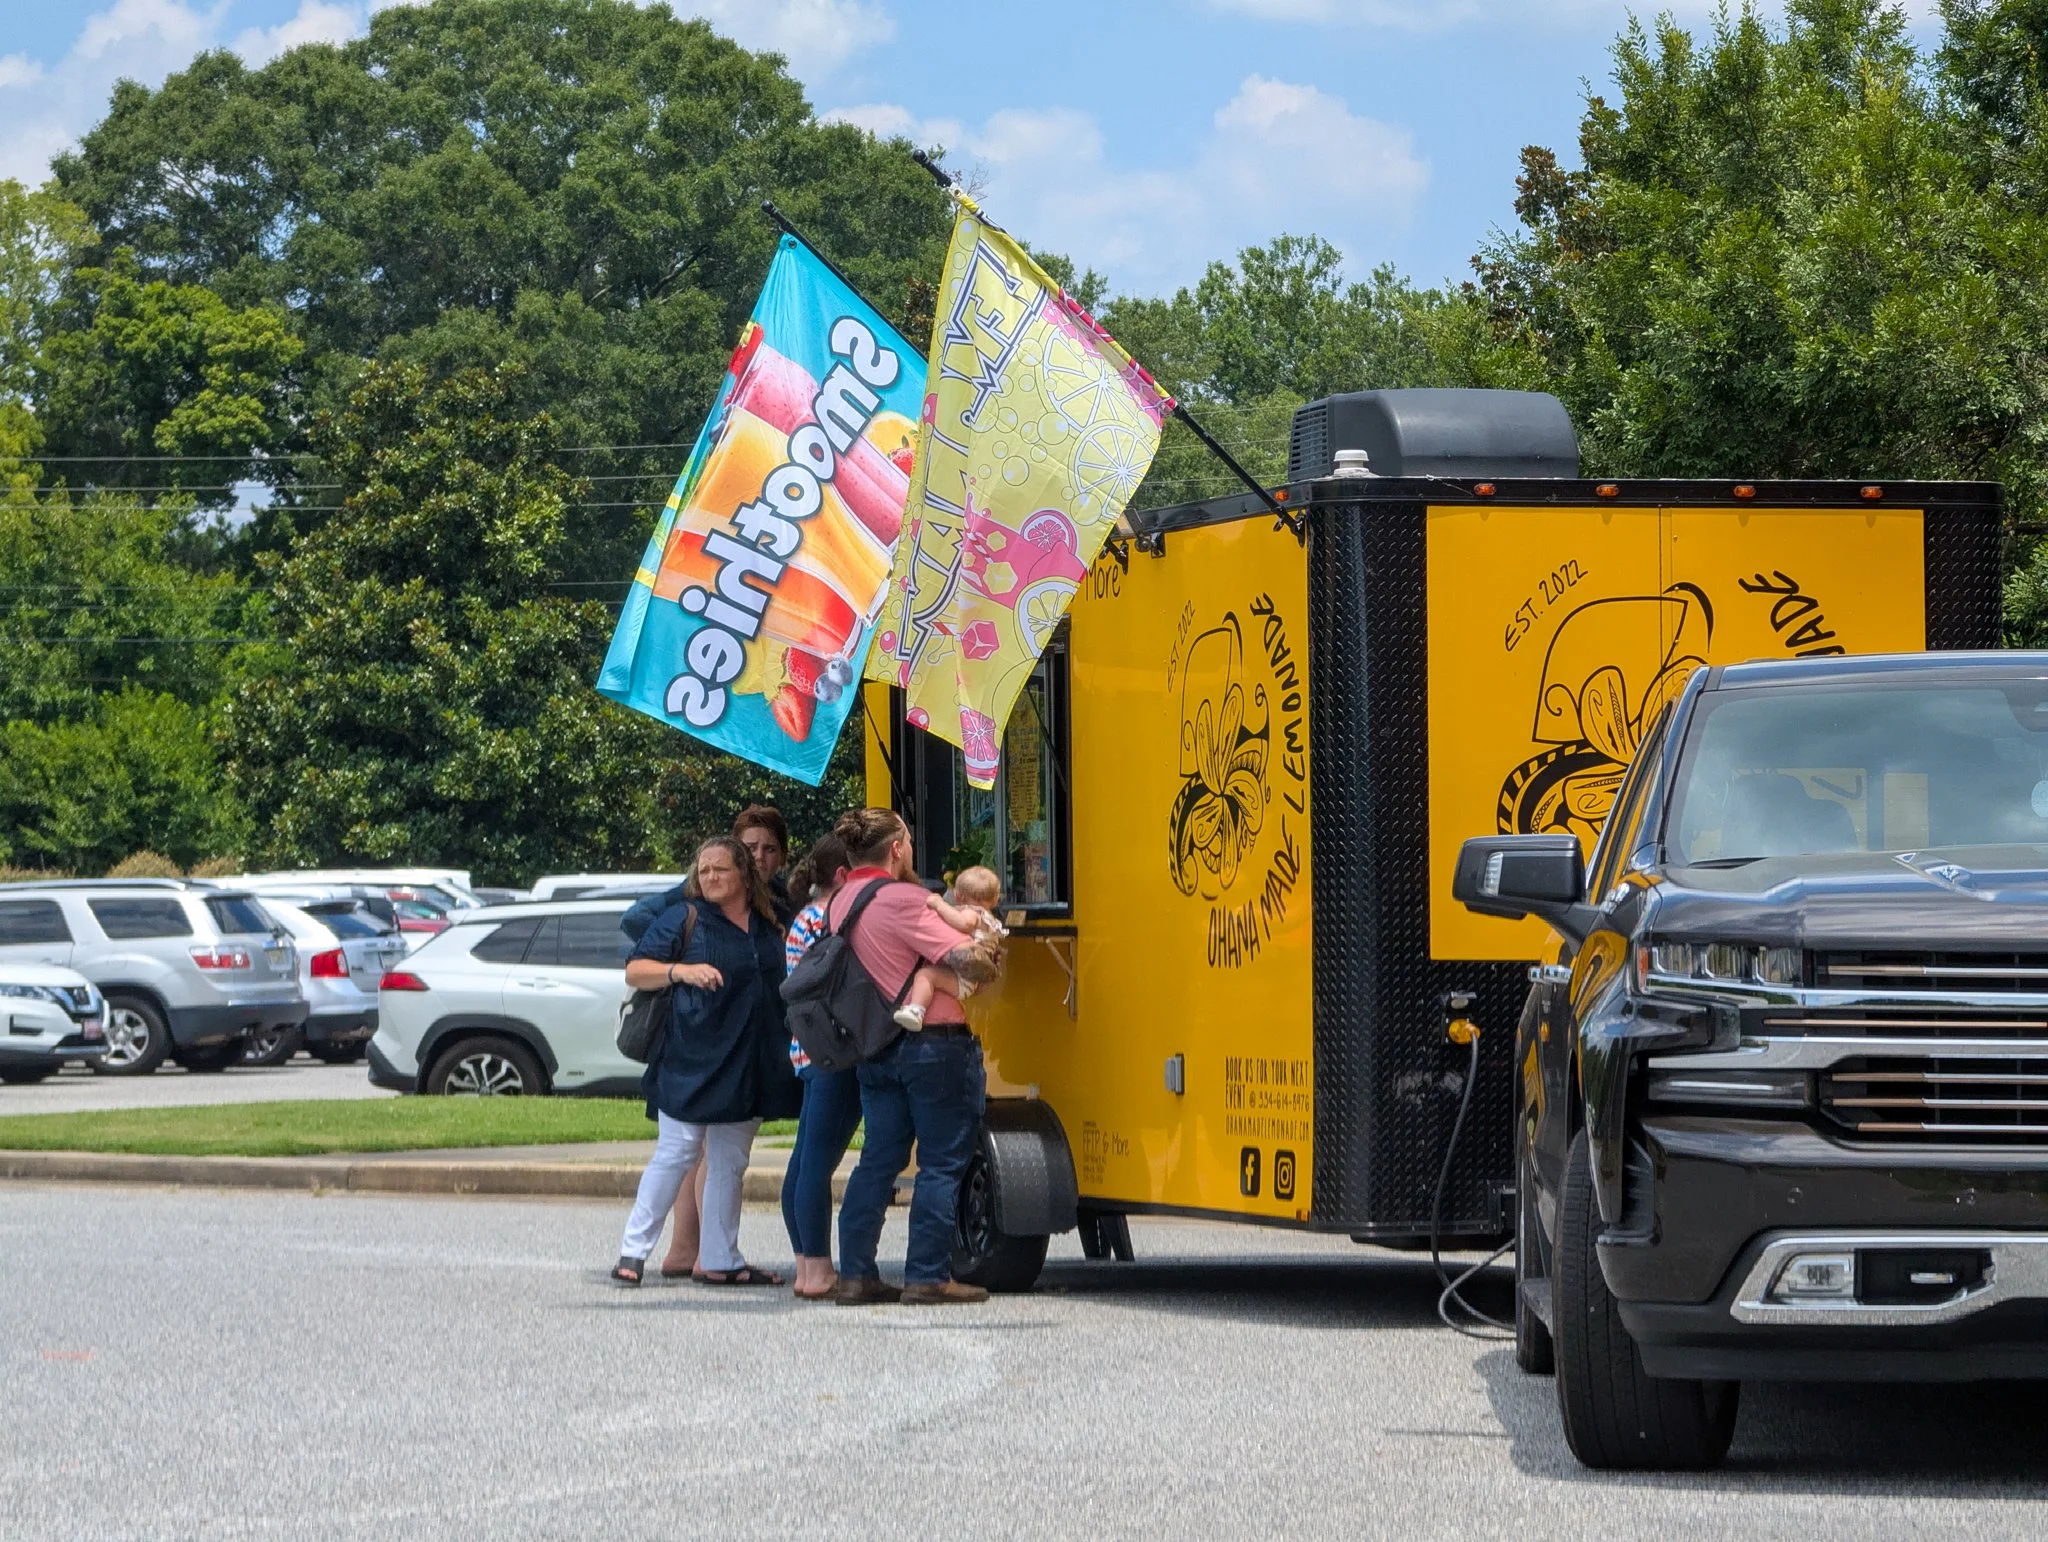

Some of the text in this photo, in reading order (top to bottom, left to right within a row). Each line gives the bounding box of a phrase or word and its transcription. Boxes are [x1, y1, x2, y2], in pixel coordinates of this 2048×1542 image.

[1085, 556, 1121, 602] More
[1177, 599, 1195, 645] 2022
[1505, 559, 1588, 651] EST. 2022
[1207, 592, 1305, 969] OHANA MADE LEMONADE
[1225, 1056, 1308, 1087] BOOK US FOR YOUR NEXT
[1225, 1082, 1246, 1110] EVENT
[1111, 1131, 1129, 1157] More
